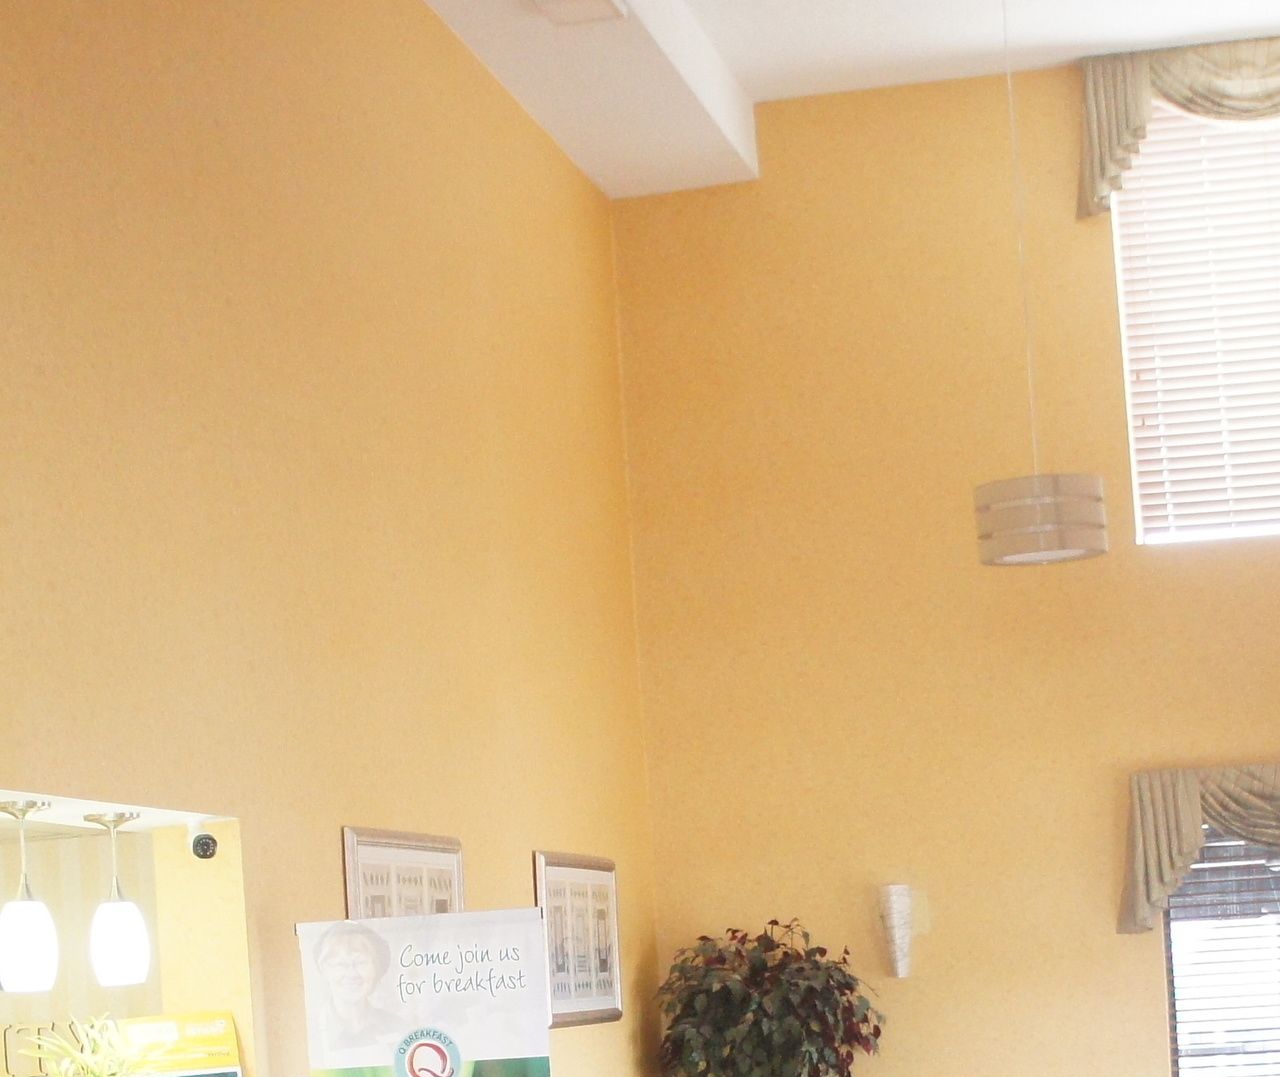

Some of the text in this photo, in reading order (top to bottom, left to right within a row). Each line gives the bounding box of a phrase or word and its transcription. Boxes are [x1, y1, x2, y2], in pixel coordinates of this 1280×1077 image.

[400, 943, 520, 974] Come join us
[397, 967, 527, 1003] for breakfast
[404, 1028, 454, 1048] BREAKFAST
